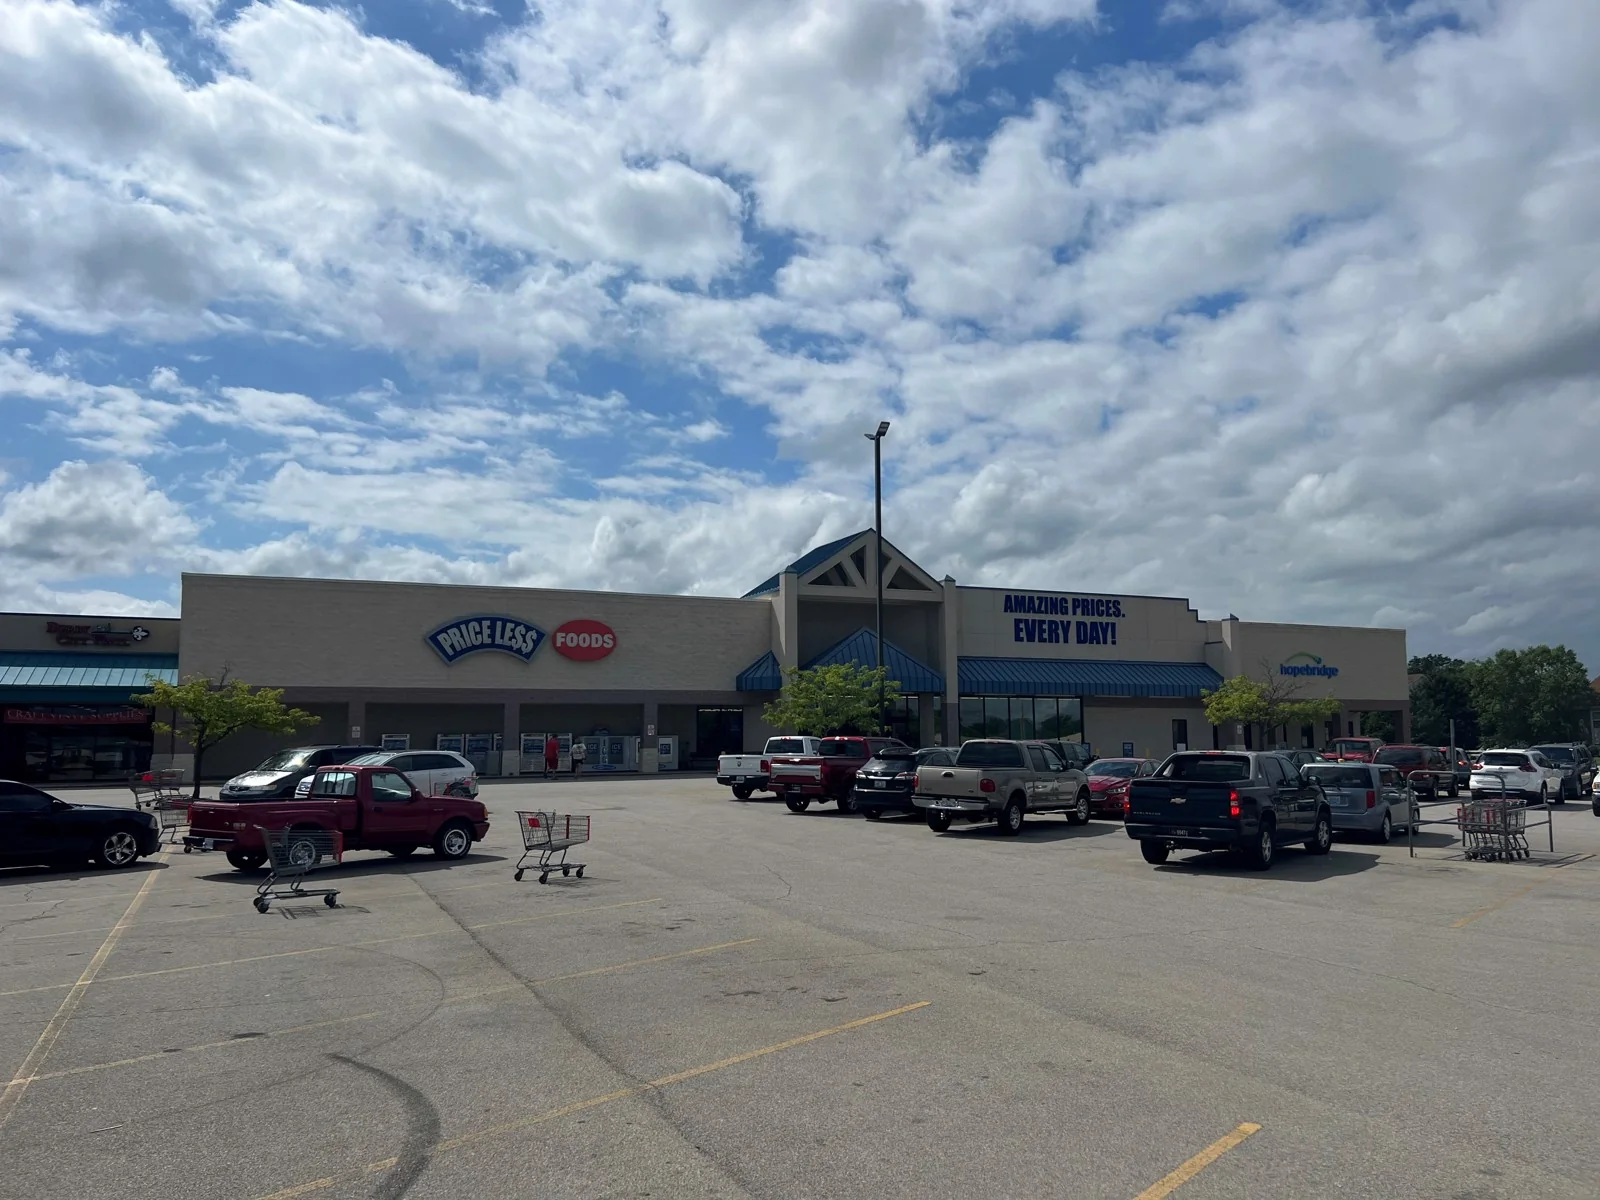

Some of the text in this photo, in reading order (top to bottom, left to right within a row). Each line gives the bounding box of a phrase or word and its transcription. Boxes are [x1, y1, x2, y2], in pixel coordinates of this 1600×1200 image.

[1004, 594, 1126, 618] AMAZING PRICES.
[436, 619, 492, 656] PRICE
[556, 632, 614, 649] FOODS
[1014, 618, 1117, 645] EVERY DAY!
[1280, 664, 1339, 679] hopebridge
